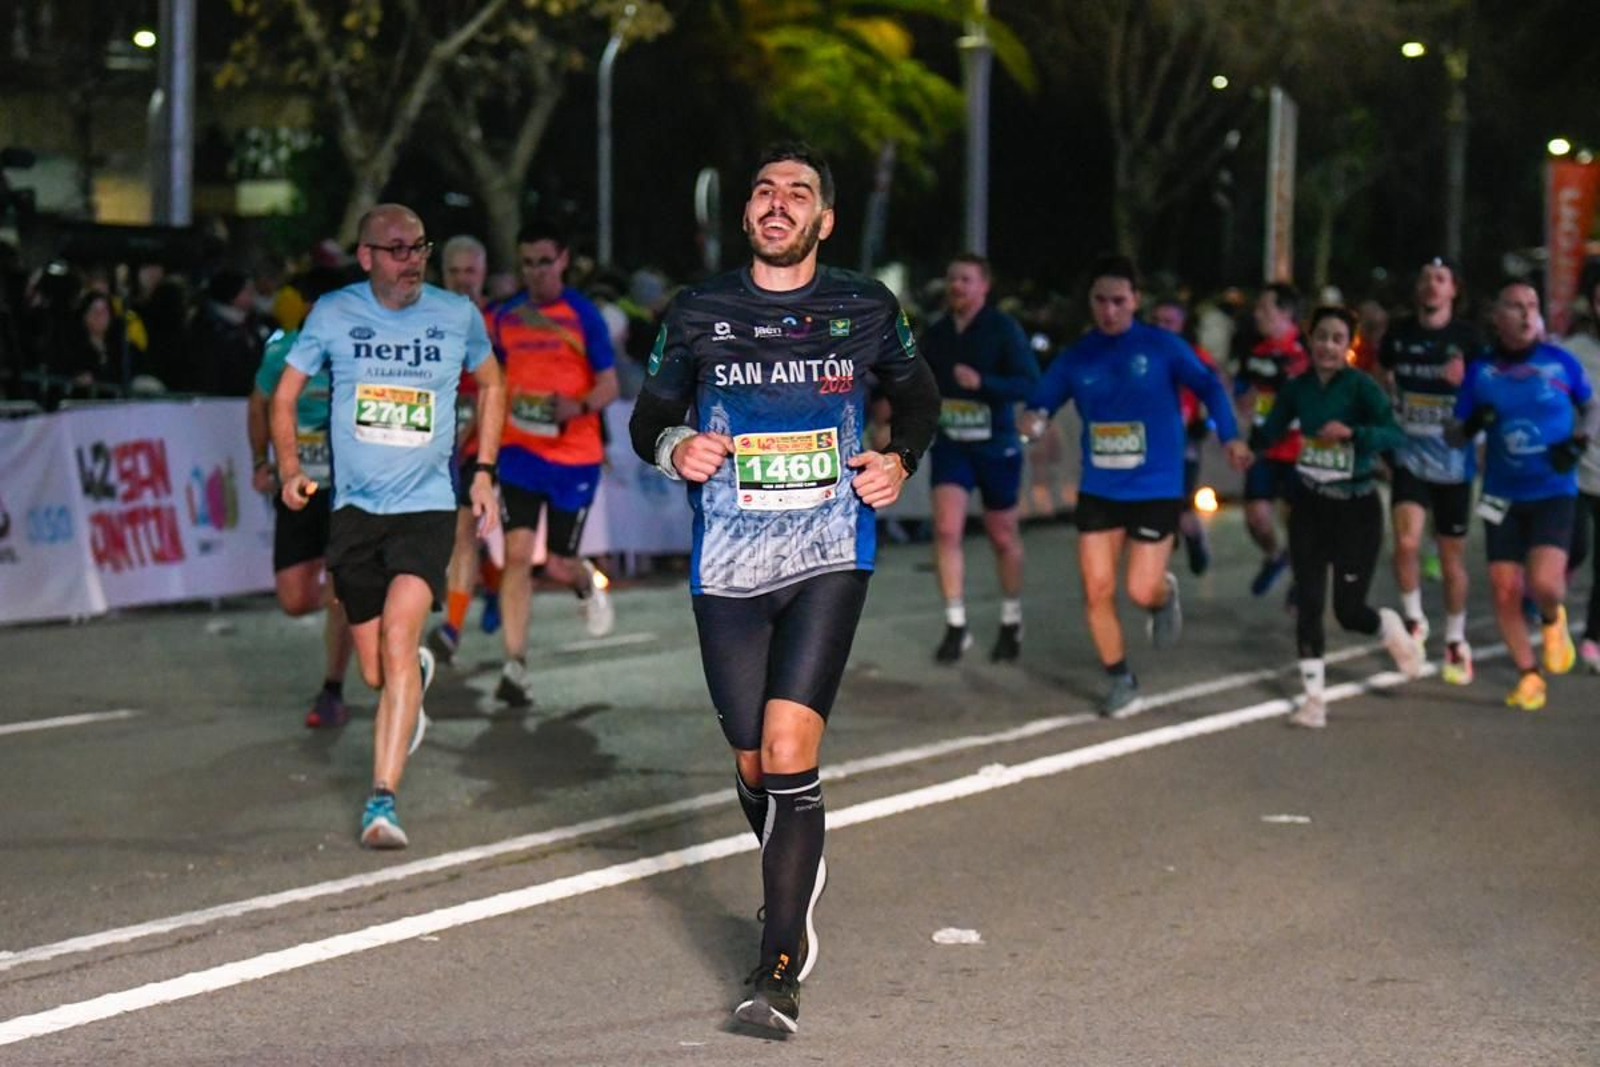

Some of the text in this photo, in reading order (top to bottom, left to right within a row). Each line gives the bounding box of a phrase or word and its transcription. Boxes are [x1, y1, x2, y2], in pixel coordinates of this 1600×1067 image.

[352, 338, 442, 368] nerja
[714, 353, 854, 387] SAN ANTÓN
[360, 400, 428, 427] 2714
[745, 451, 832, 482] 1460
